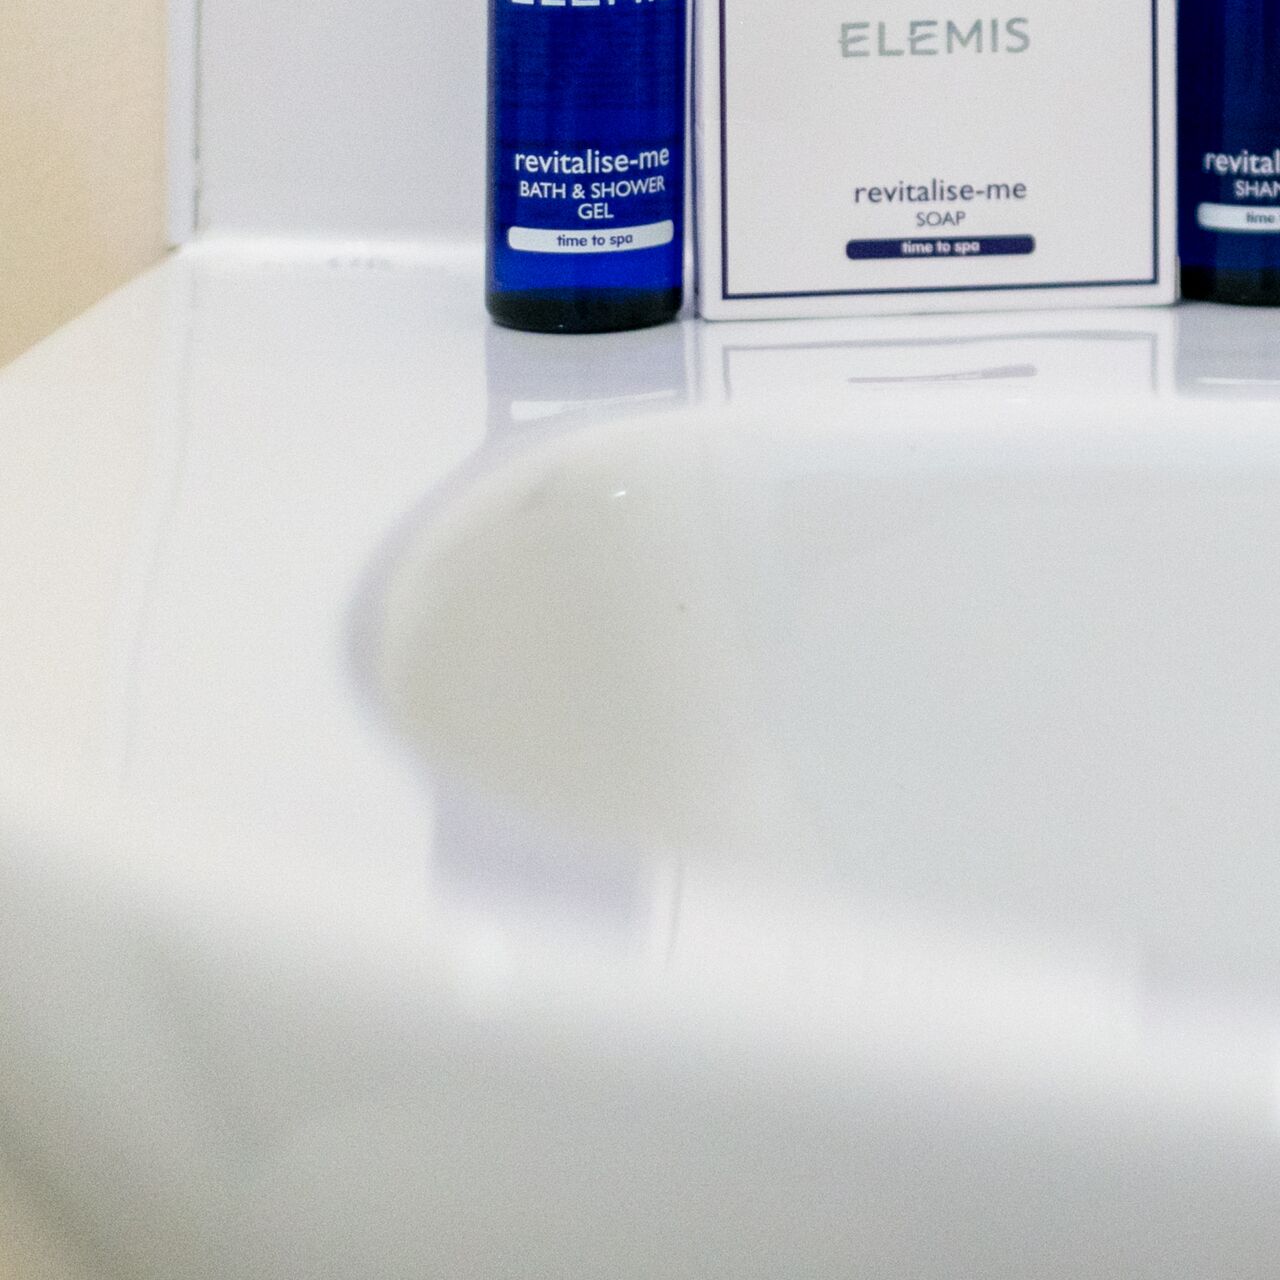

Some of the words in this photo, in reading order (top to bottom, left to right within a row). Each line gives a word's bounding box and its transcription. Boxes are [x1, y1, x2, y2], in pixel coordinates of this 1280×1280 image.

[838, 16, 1030, 58] ELEMIS
[514, 147, 670, 174] revitalise-me
[519, 180, 567, 199] BATH
[571, 183, 586, 199] &
[590, 175, 665, 199] SHOWER
[854, 177, 1027, 203] revitalise-me
[577, 202, 614, 220] GEL
[916, 210, 966, 227] SOAP
[1246, 211, 1276, 224] time
[556, 234, 588, 247] time
[592, 234, 606, 246] to
[609, 233, 633, 248] spa
[901, 240, 934, 254] time
[936, 240, 951, 253] to
[954, 241, 980, 255] spa
